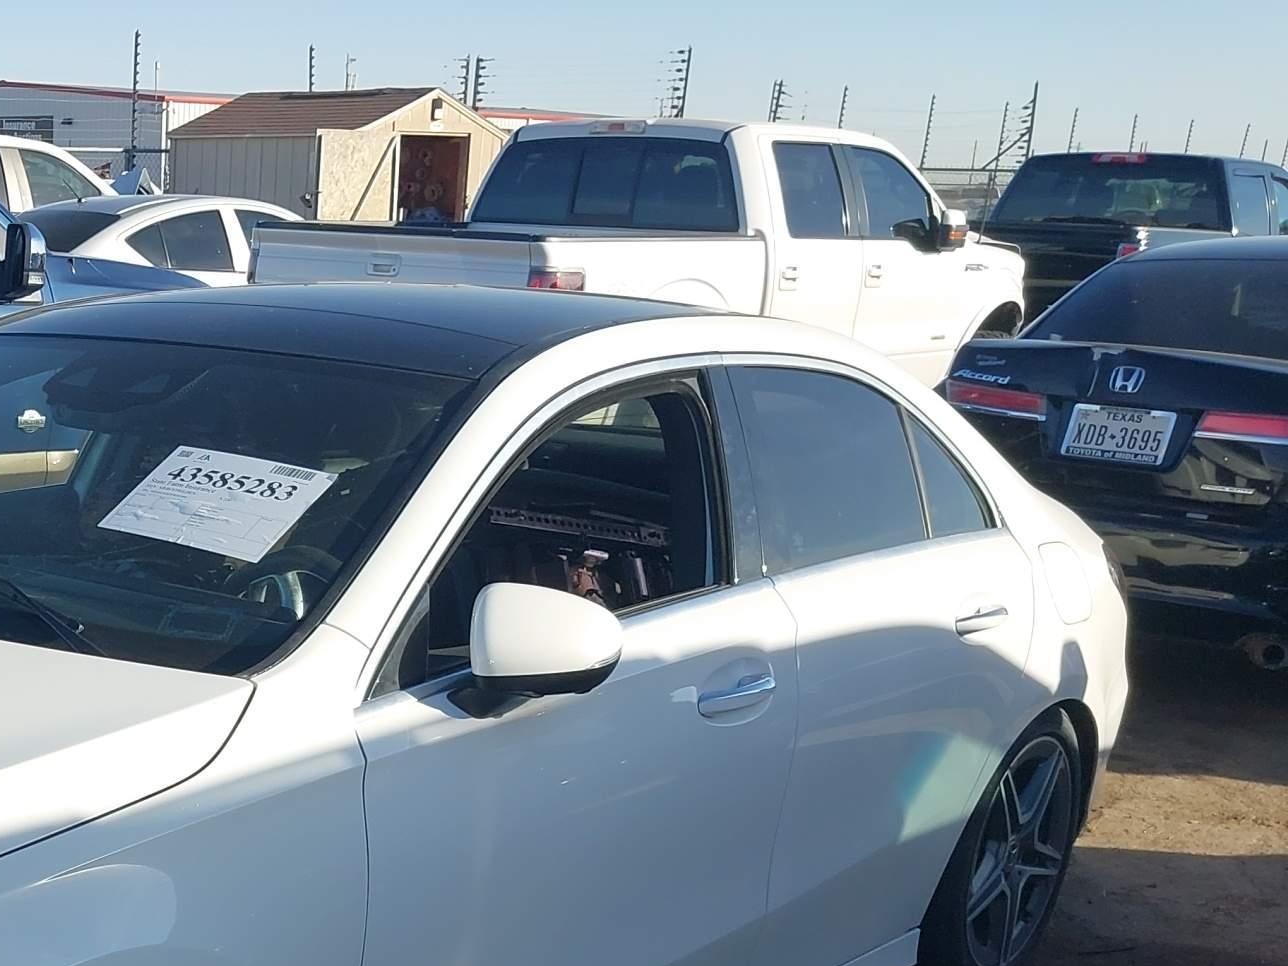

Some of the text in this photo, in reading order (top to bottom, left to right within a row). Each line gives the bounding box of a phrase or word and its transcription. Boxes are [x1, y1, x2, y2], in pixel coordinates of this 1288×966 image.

[952, 368, 1012, 385] Accord
[1105, 411, 1144, 424] TEXAS
[1069, 446, 1102, 457] TOYOTA
[1114, 452, 1156, 462] MIDLAND
[167, 465, 299, 501] 43585283
